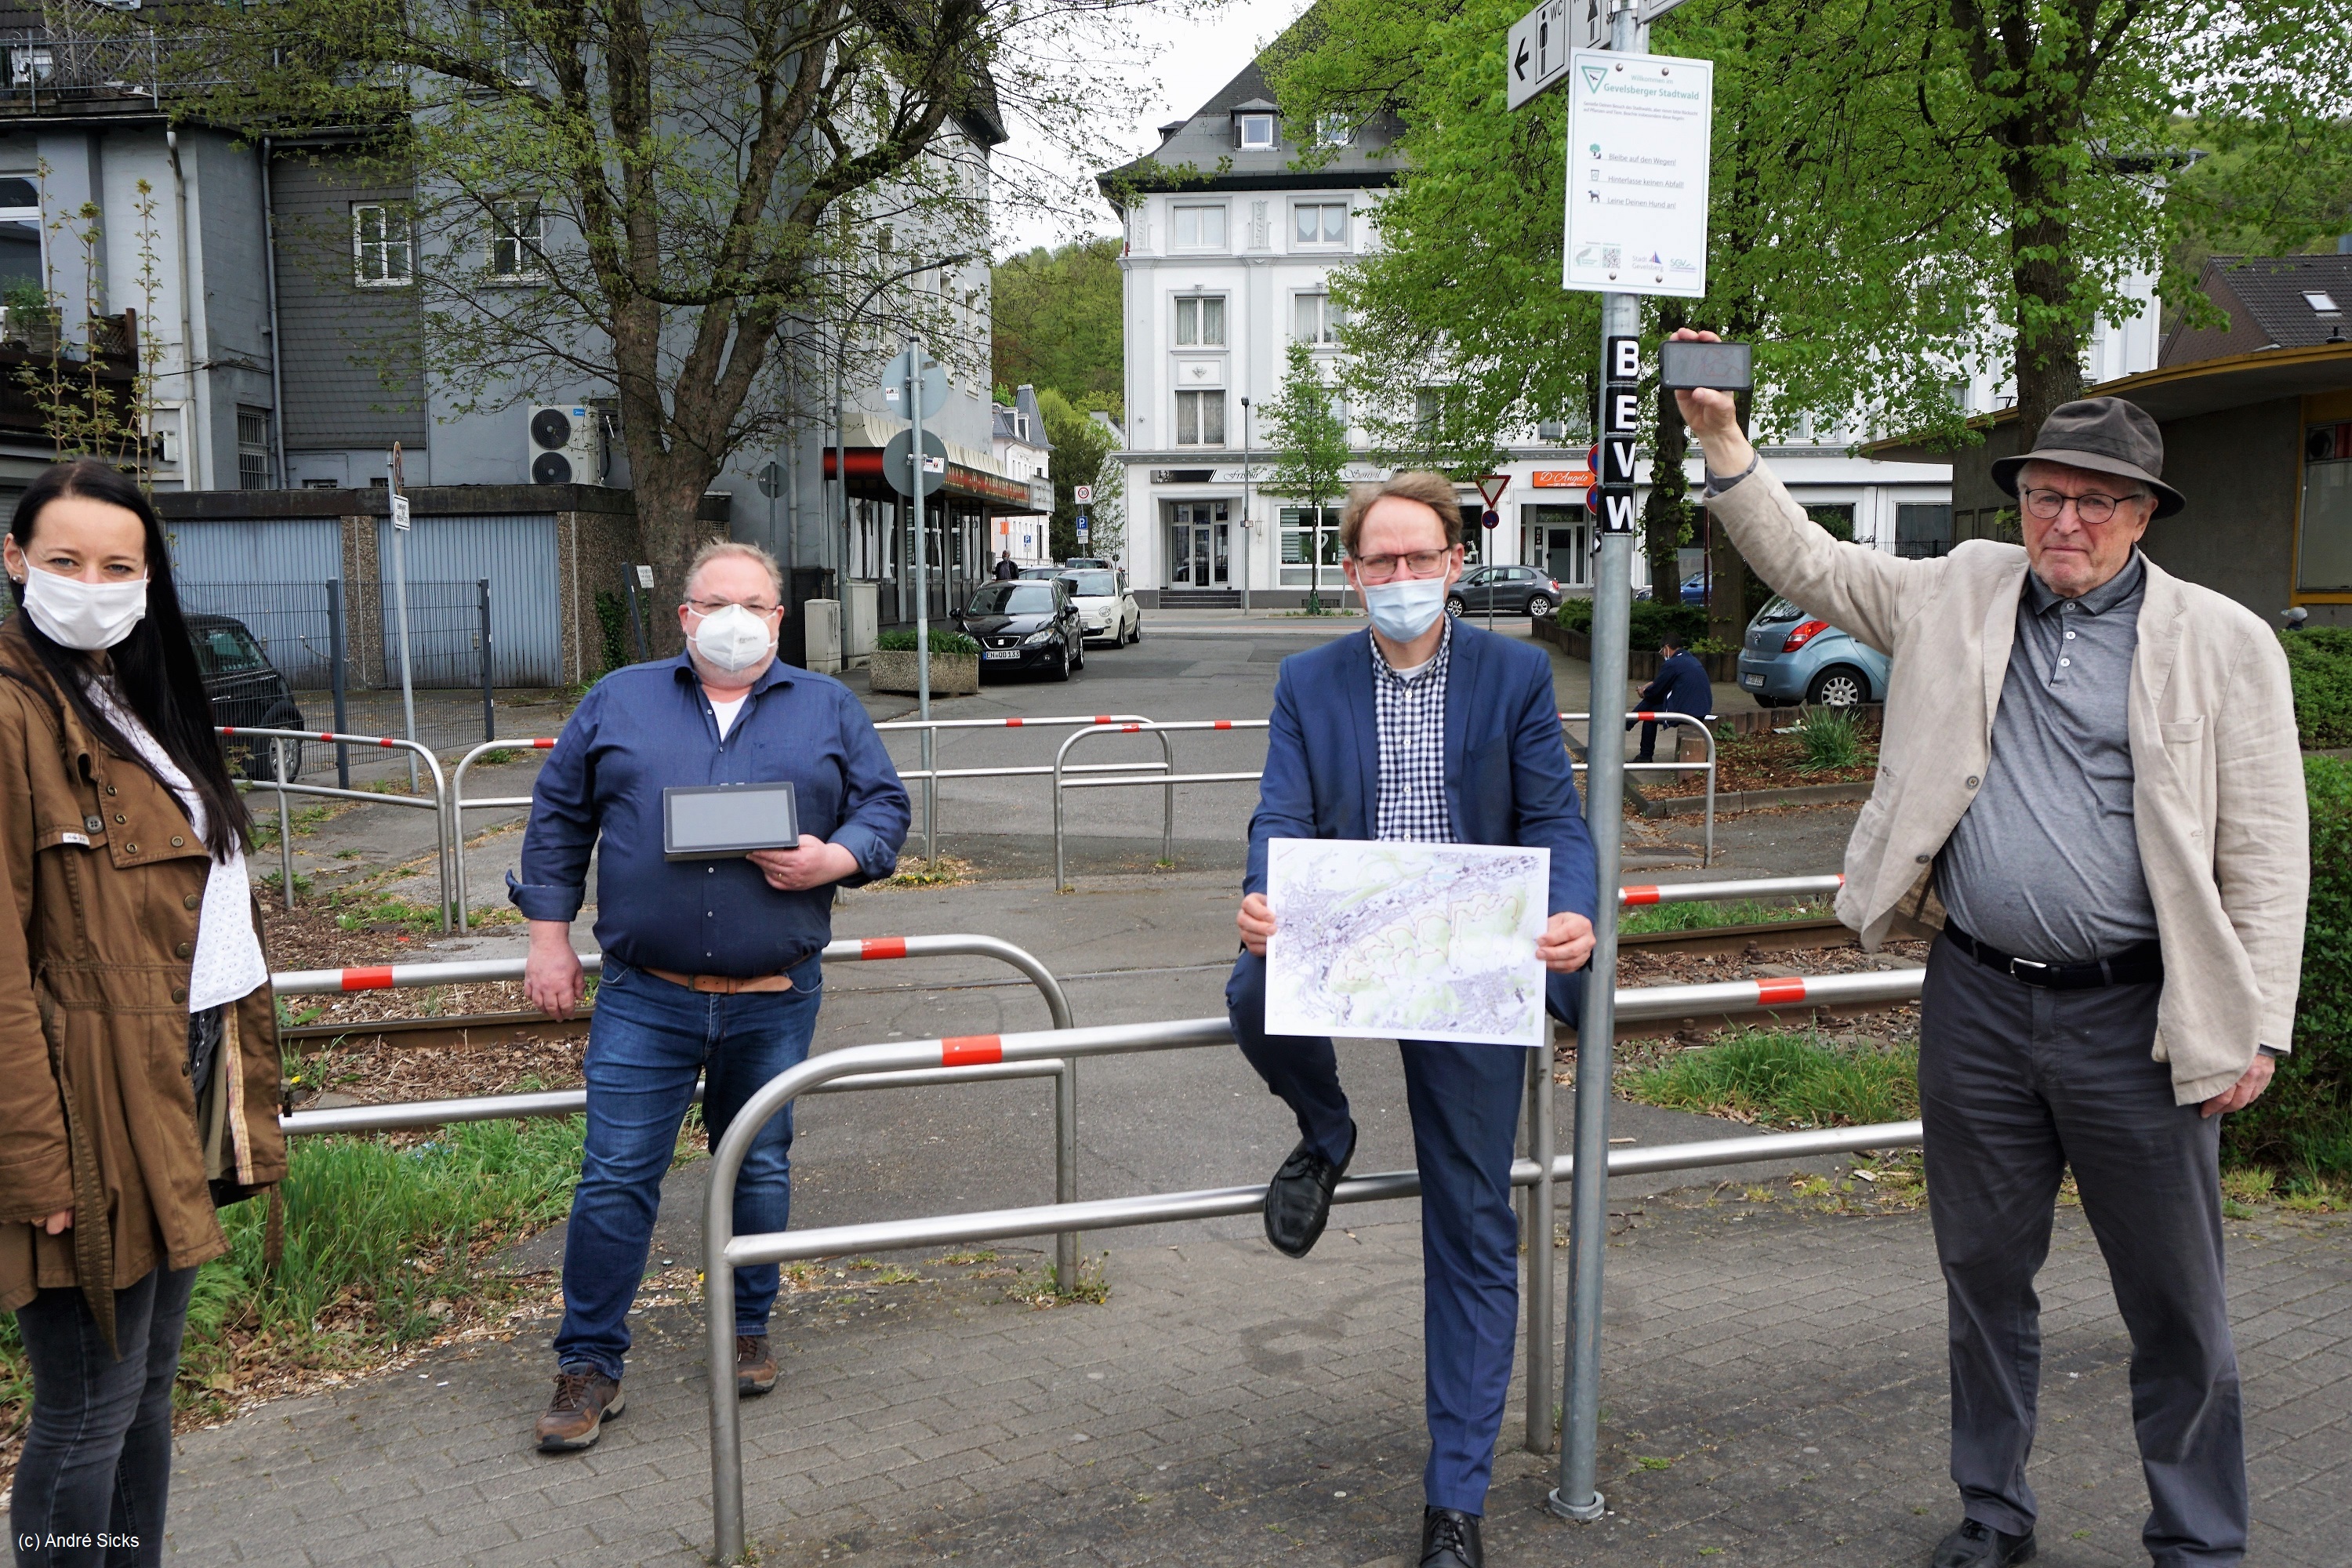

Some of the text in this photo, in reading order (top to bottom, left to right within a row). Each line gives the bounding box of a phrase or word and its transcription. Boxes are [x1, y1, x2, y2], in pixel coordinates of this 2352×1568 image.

[1551, 0, 1563, 21] WC
[1631, 74, 1665, 84] Willkommen
[1604, 83, 1699, 100] Gevelsberger Stadtwald
[1653, 158, 1676, 166] Wegen!
[1608, 176, 1642, 184] Hinterlasse
[1643, 178, 1663, 187] keinen
[1632, 263, 1664, 273] Gevelsberg
[1617, 340, 1639, 376] B
[1615, 394, 1637, 430] E
[1613, 441, 1636, 477] V
[1540, 471, 1588, 483] D'Angelo
[1606, 495, 1635, 530] W
[1079, 518, 1085, 528] P
